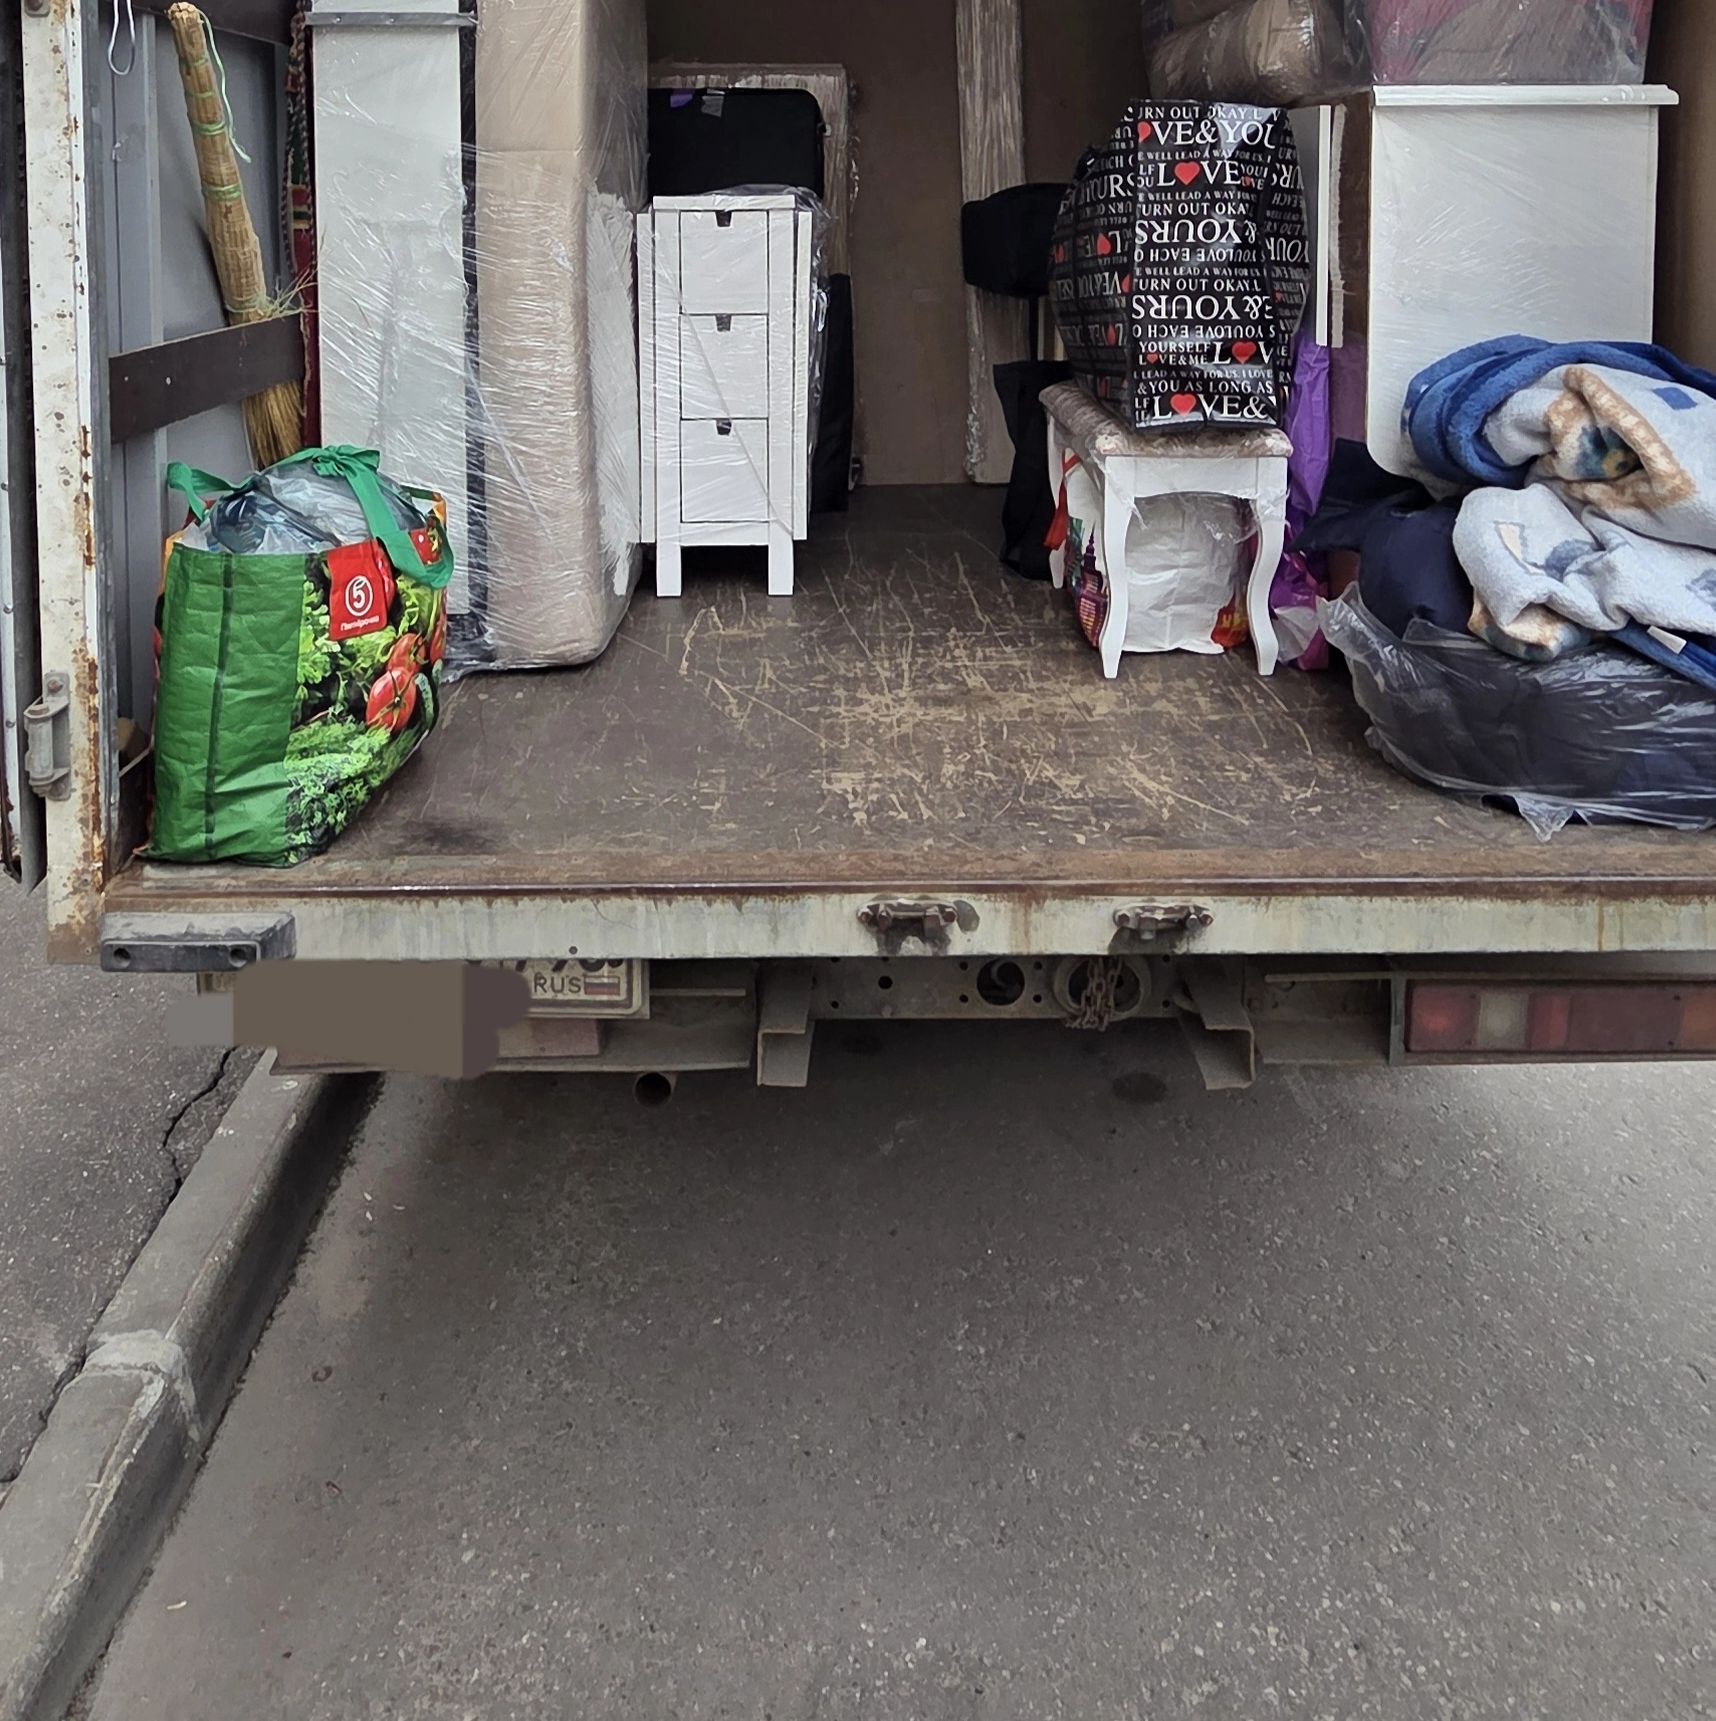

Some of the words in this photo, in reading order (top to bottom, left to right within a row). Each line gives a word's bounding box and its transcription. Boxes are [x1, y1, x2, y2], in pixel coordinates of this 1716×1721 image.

[1178, 202, 1210, 216] OUT
[1176, 278, 1209, 291] OUT
[1185, 381, 1203, 392] AS
[1209, 381, 1252, 393] LONG
[1257, 381, 1274, 394] AS
[533, 976, 582, 994] RUS
